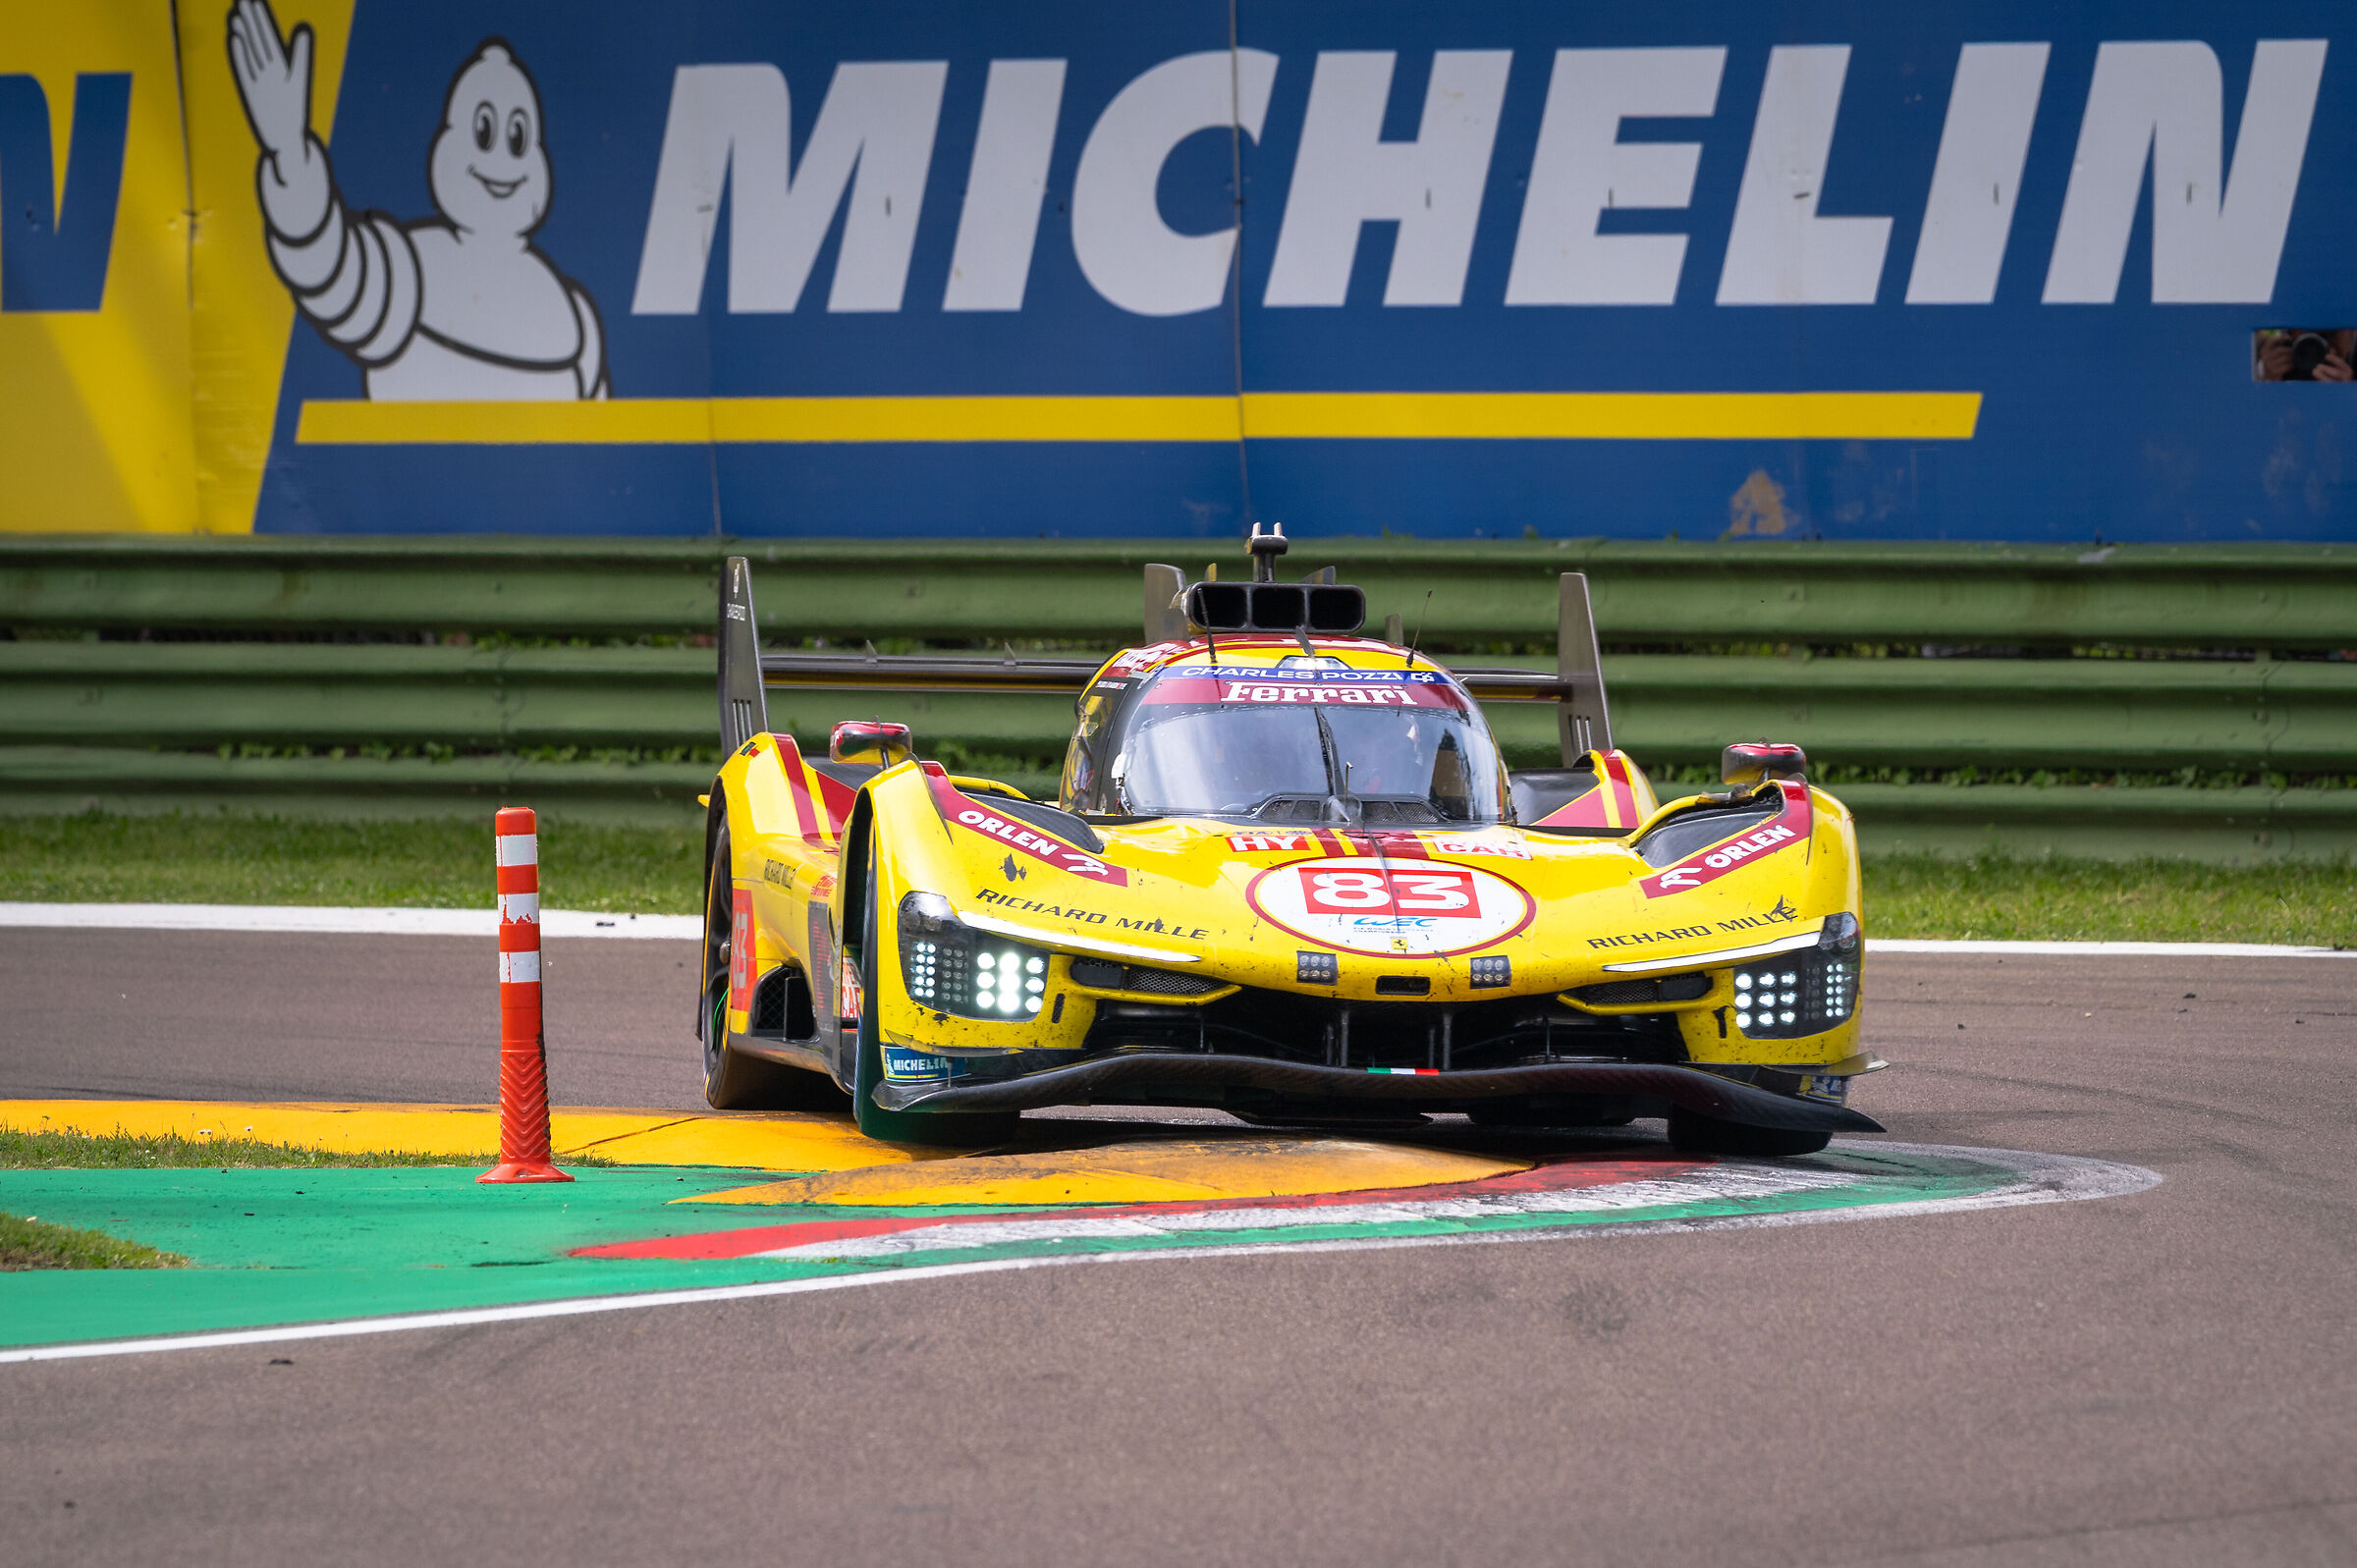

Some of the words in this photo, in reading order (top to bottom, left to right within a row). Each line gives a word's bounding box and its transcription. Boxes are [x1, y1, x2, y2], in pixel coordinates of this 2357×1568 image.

[631, 39, 2329, 316] MICHELIN
[1181, 667, 1316, 679] CHARLES
[1322, 671, 1403, 680] POZZI
[1221, 681, 1418, 705] Ferrari
[958, 810, 1061, 856] ORLEN
[1230, 836, 1299, 851] HY
[1705, 825, 1796, 868] ORLEN
[1312, 872, 1470, 910] 83
[975, 888, 1108, 924] RICHARD
[1116, 917, 1210, 940] MILLE
[1353, 917, 1438, 927] WEC
[1586, 925, 1712, 949] RICHARD
[1717, 905, 1799, 933] MILLE
[733, 911, 748, 990] 83
[894, 1057, 950, 1071] MICHELIN
